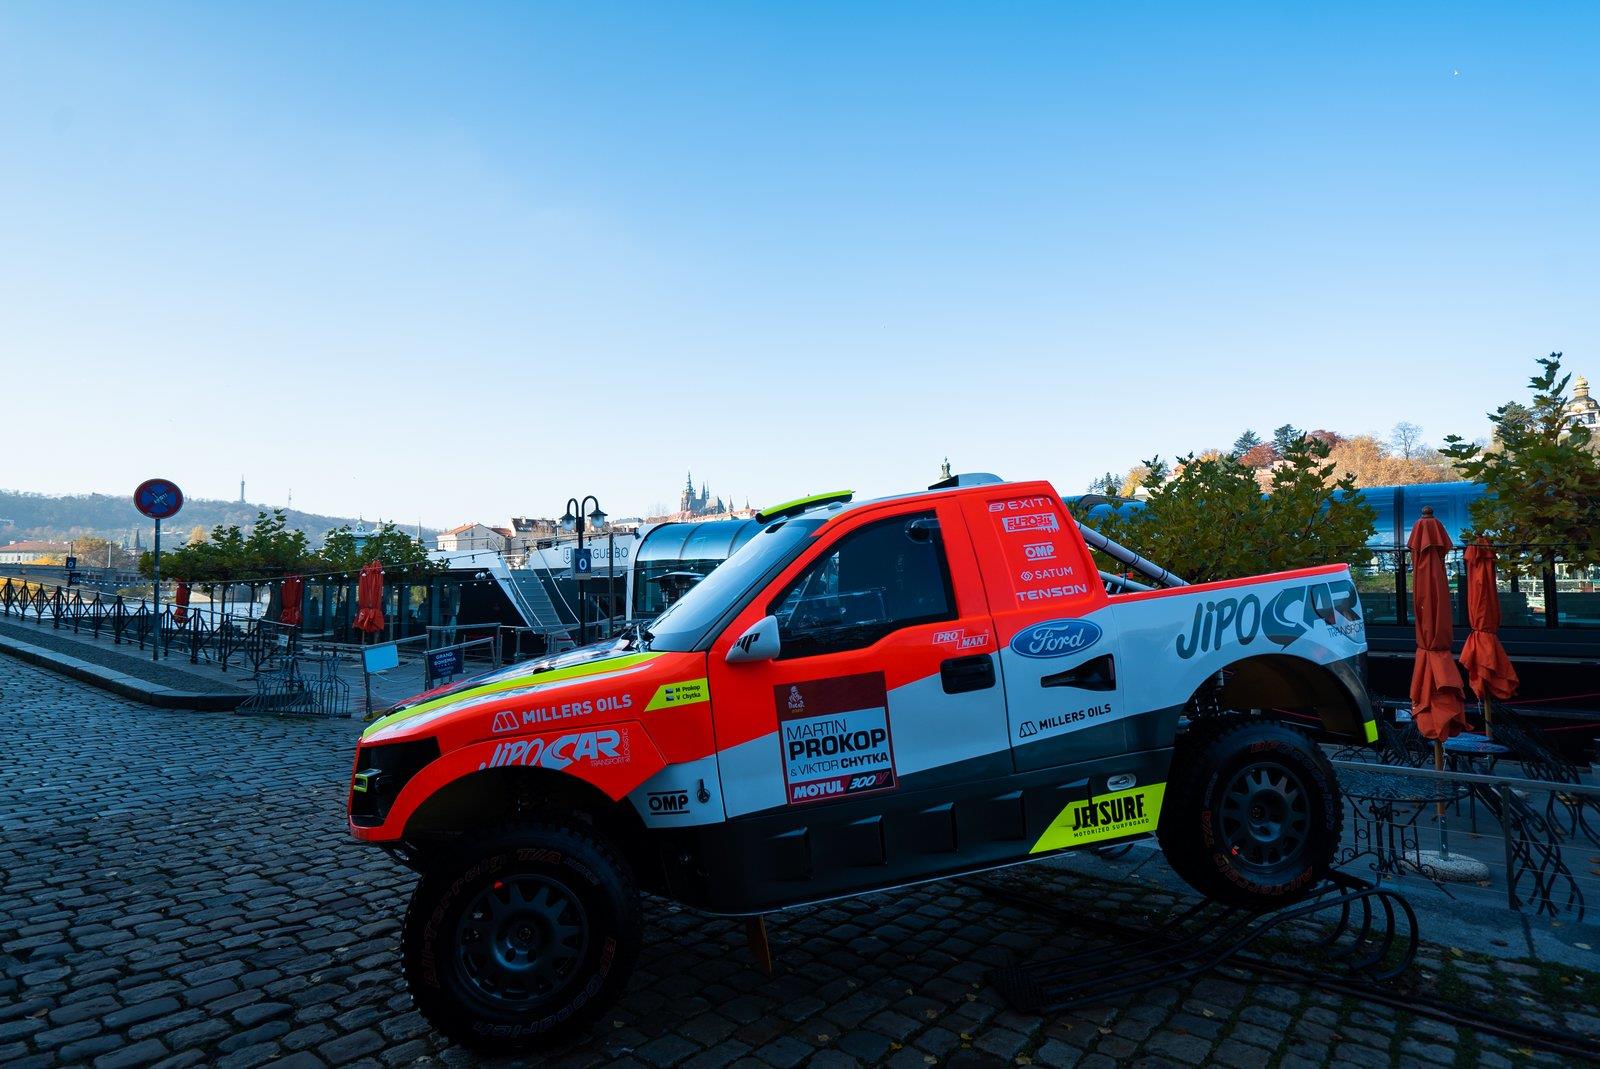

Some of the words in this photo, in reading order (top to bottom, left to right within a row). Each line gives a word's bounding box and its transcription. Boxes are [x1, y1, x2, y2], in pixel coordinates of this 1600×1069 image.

[1025, 546, 1055, 559] OMP
[1035, 566, 1073, 580] SATUM
[1017, 584, 1087, 601] TENSON
[937, 631, 958, 643] PRO
[962, 636, 984, 648] MAN
[1029, 625, 1086, 654] Ford
[682, 685, 701, 693] Prokop
[682, 692, 701, 700] Chytka
[522, 700, 593, 725] MILLERS
[596, 694, 633, 711] OILS
[1039, 709, 1086, 731] MILLERS
[1087, 703, 1112, 718] OILS
[786, 718, 847, 741] MARTIN
[789, 728, 886, 761] PROKOP
[790, 767, 798, 777] &
[799, 760, 840, 777] VIKTOR
[840, 752, 889, 770] CHYTKA
[794, 780, 844, 799] MOTUL
[849, 772, 890, 790] 300V
[648, 791, 689, 811] OMP
[1073, 794, 1145, 831] JETSURF
[1073, 827, 1110, 838] MOTORIZED
[1112, 818, 1150, 830] SURFBOARD
